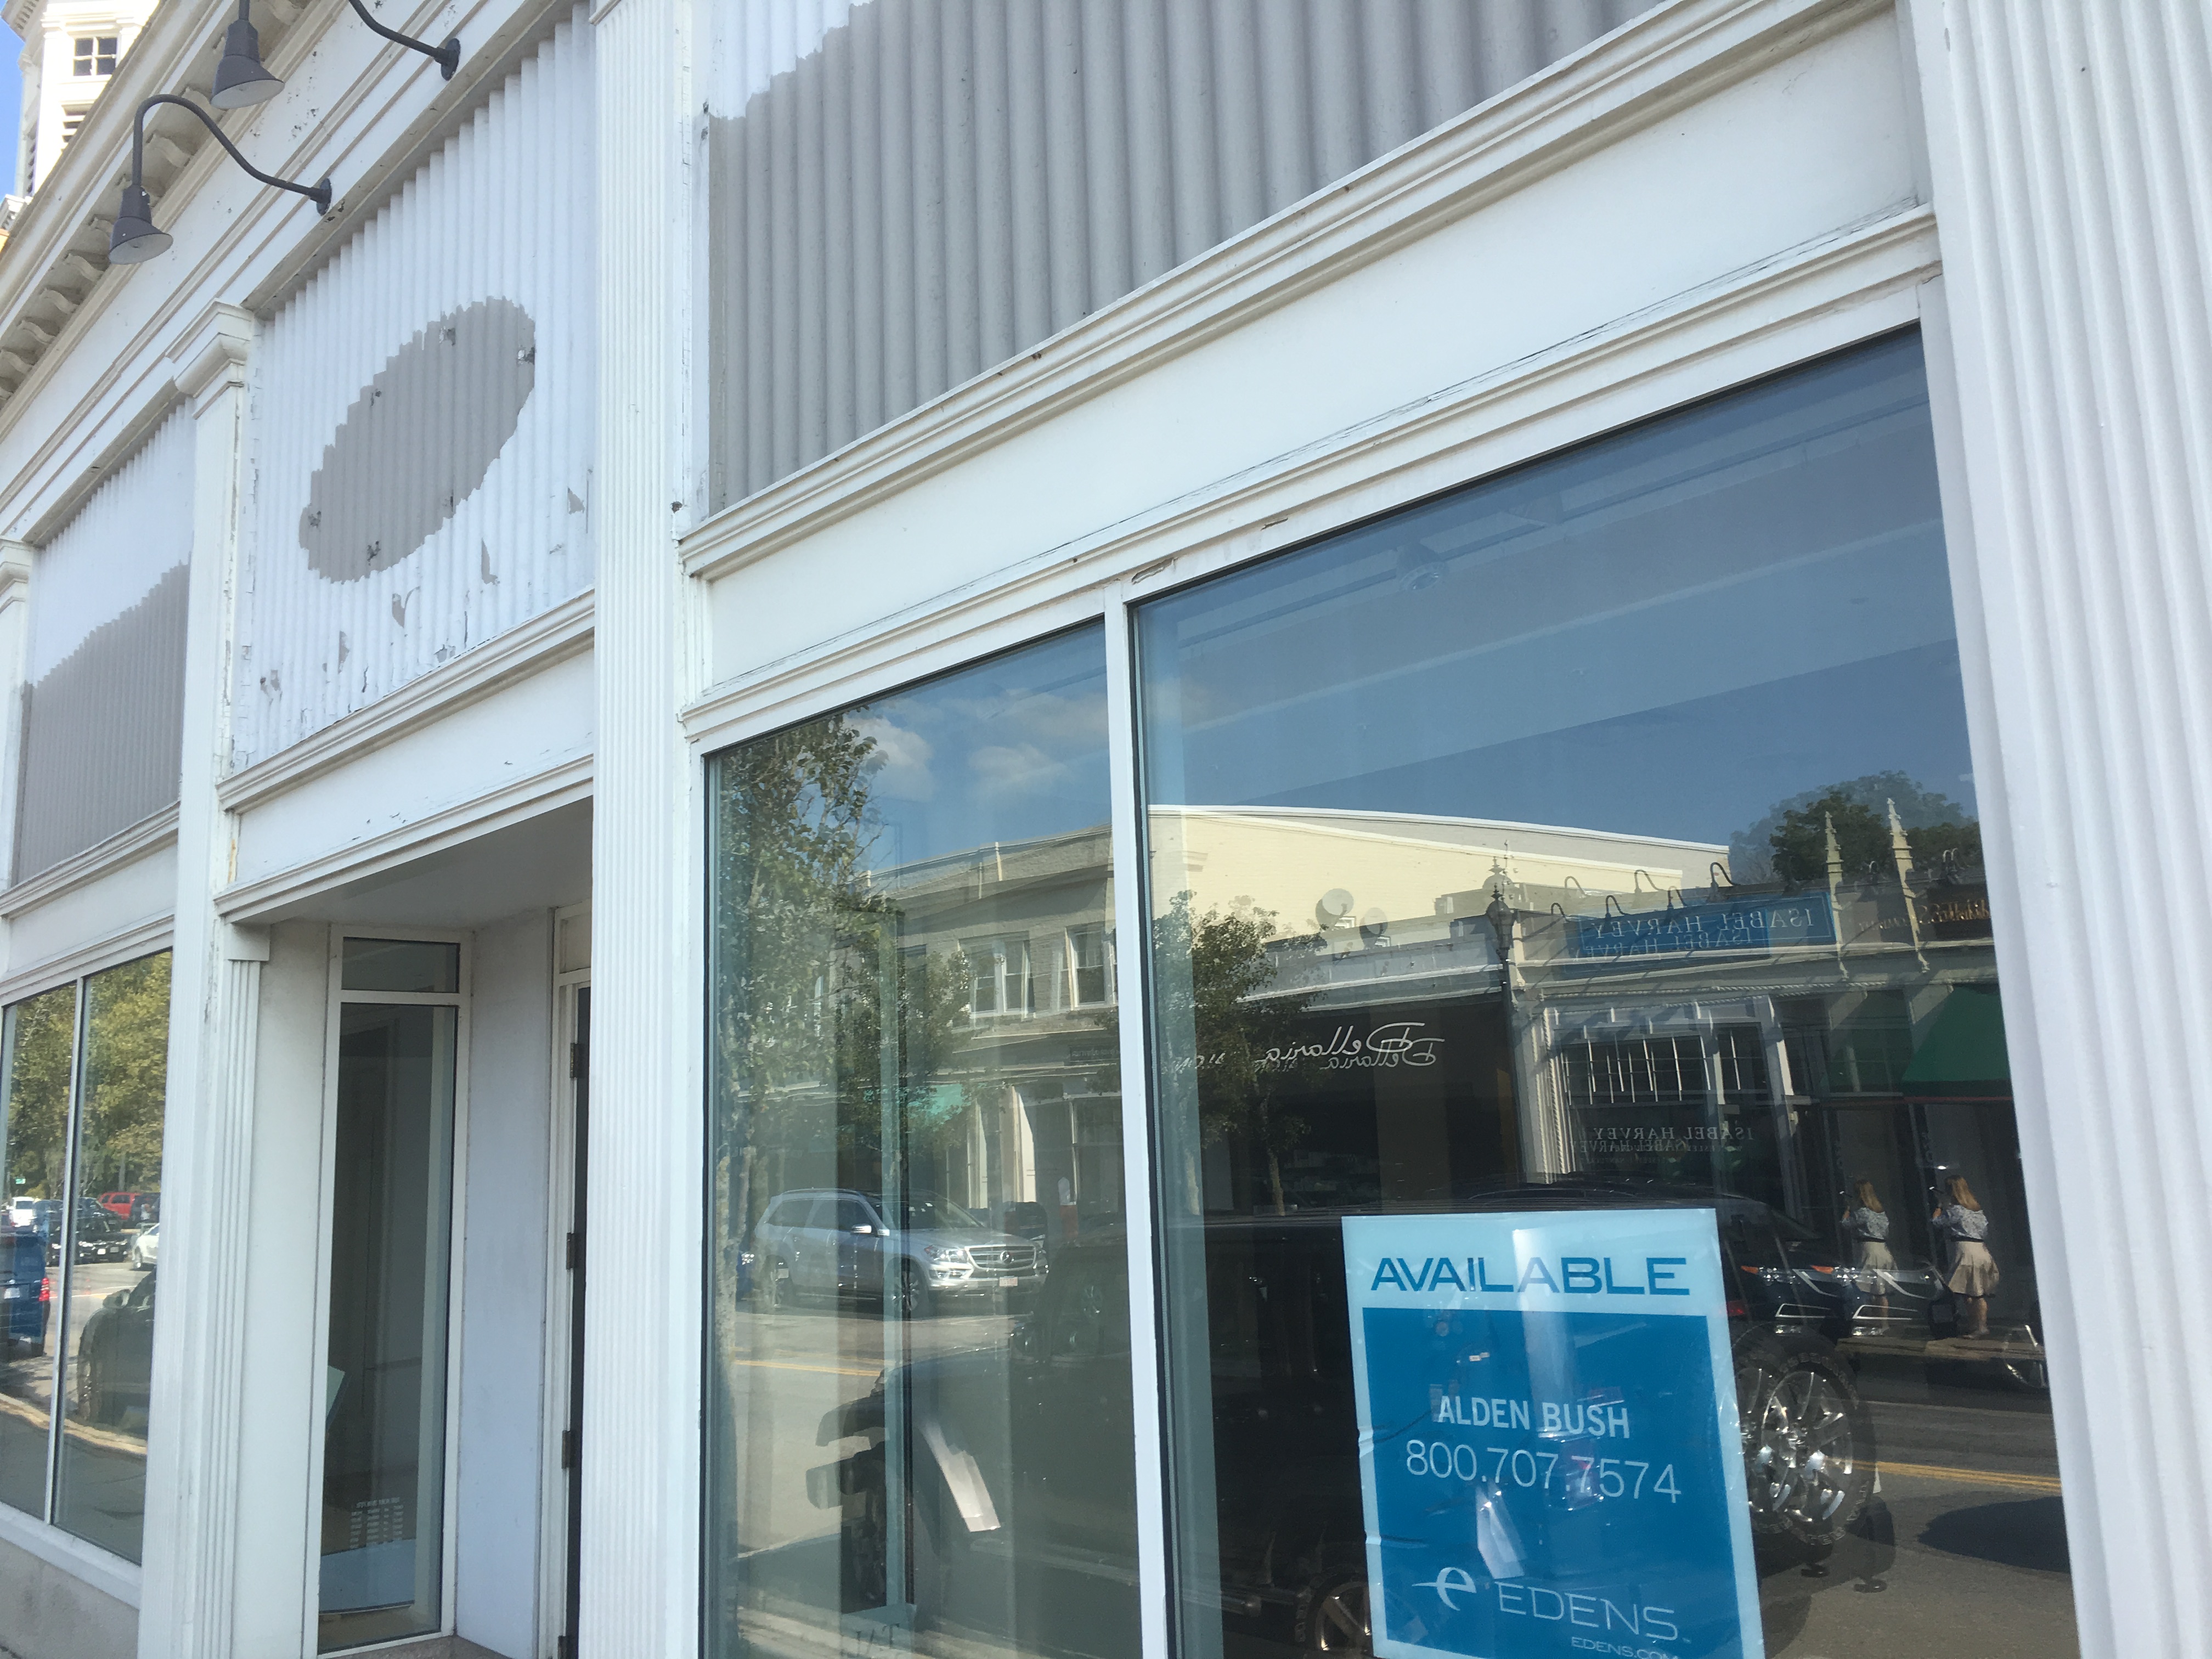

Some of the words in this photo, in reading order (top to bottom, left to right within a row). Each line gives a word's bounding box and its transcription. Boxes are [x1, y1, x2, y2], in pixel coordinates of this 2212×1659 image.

[1370, 1257, 1690, 1295] AVAILABLE
[1438, 1395, 1530, 1430] ALDEN
[1542, 1401, 1630, 1438] BUSH
[1406, 1439, 1682, 1504] 800.707.7574
[1494, 1581, 1678, 1641] EDENS
